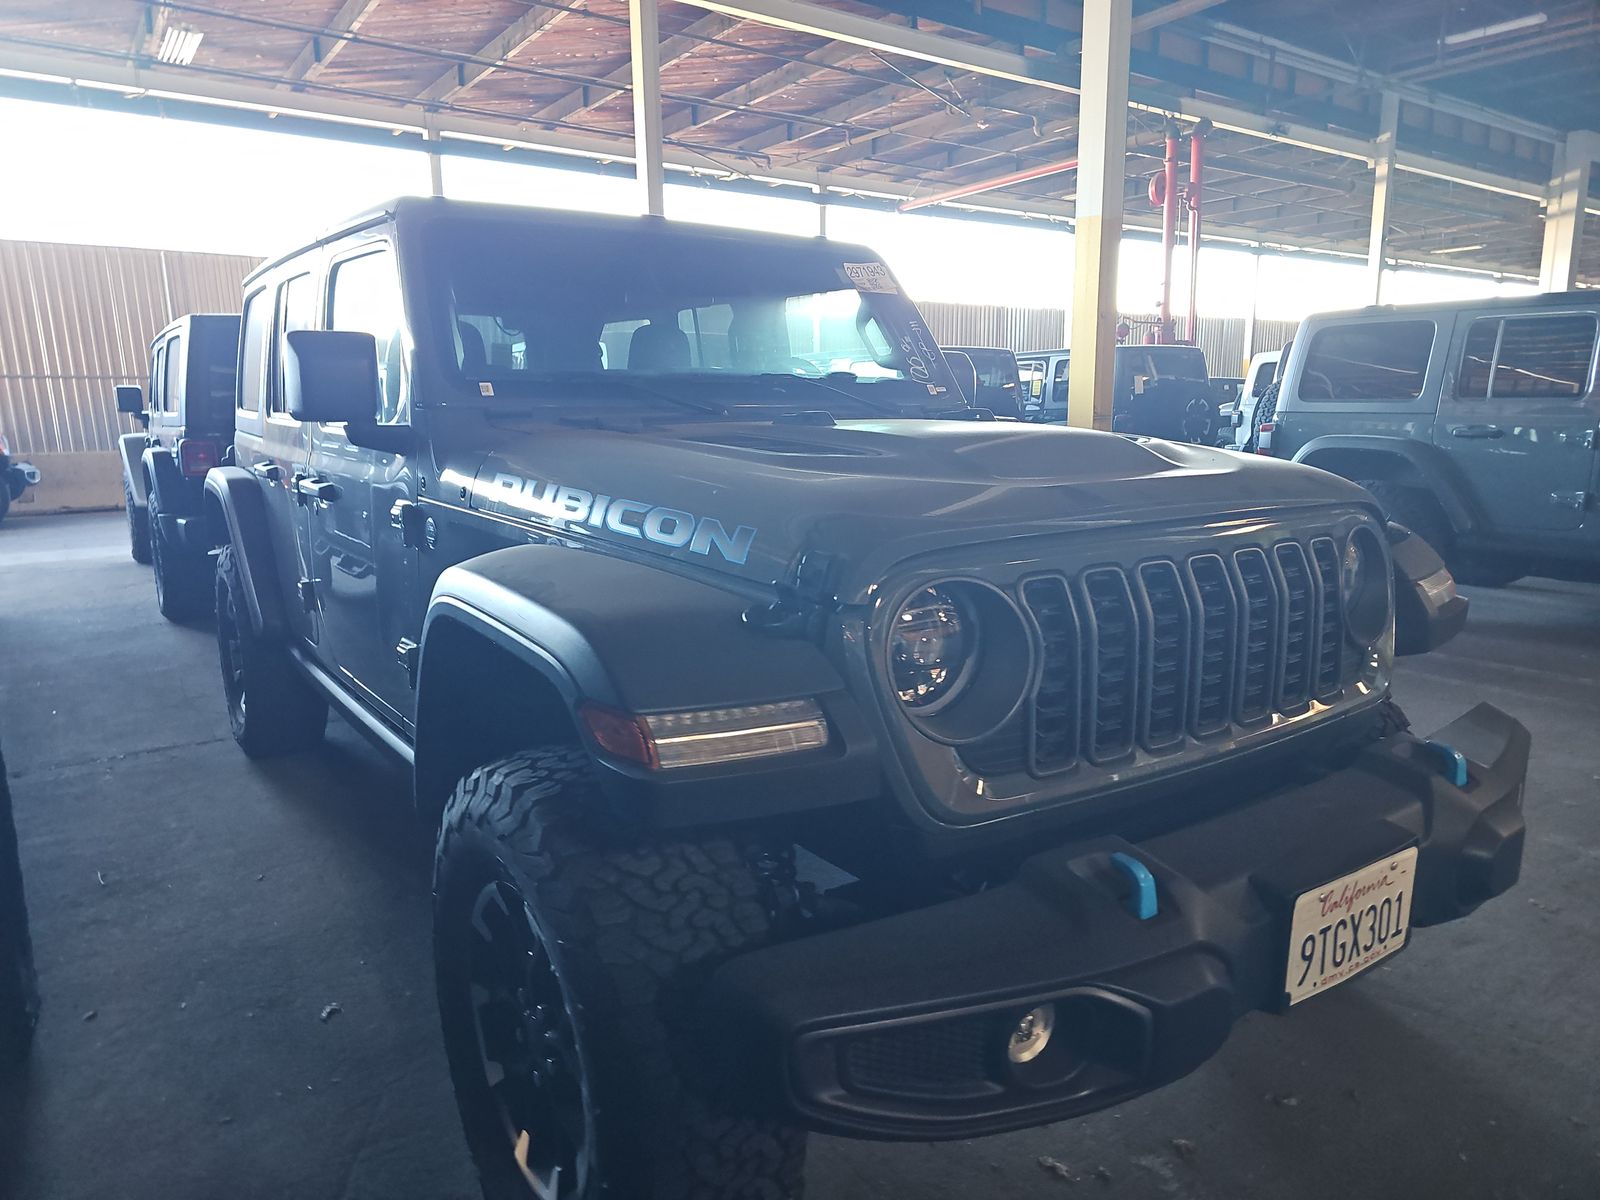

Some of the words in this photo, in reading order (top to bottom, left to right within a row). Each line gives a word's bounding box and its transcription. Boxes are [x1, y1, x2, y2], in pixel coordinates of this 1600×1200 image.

[846, 265, 886, 279] 2971943
[493, 472, 758, 565] RUBICON
[1321, 873, 1395, 918] California
[1297, 890, 1404, 988] 9TGX301
